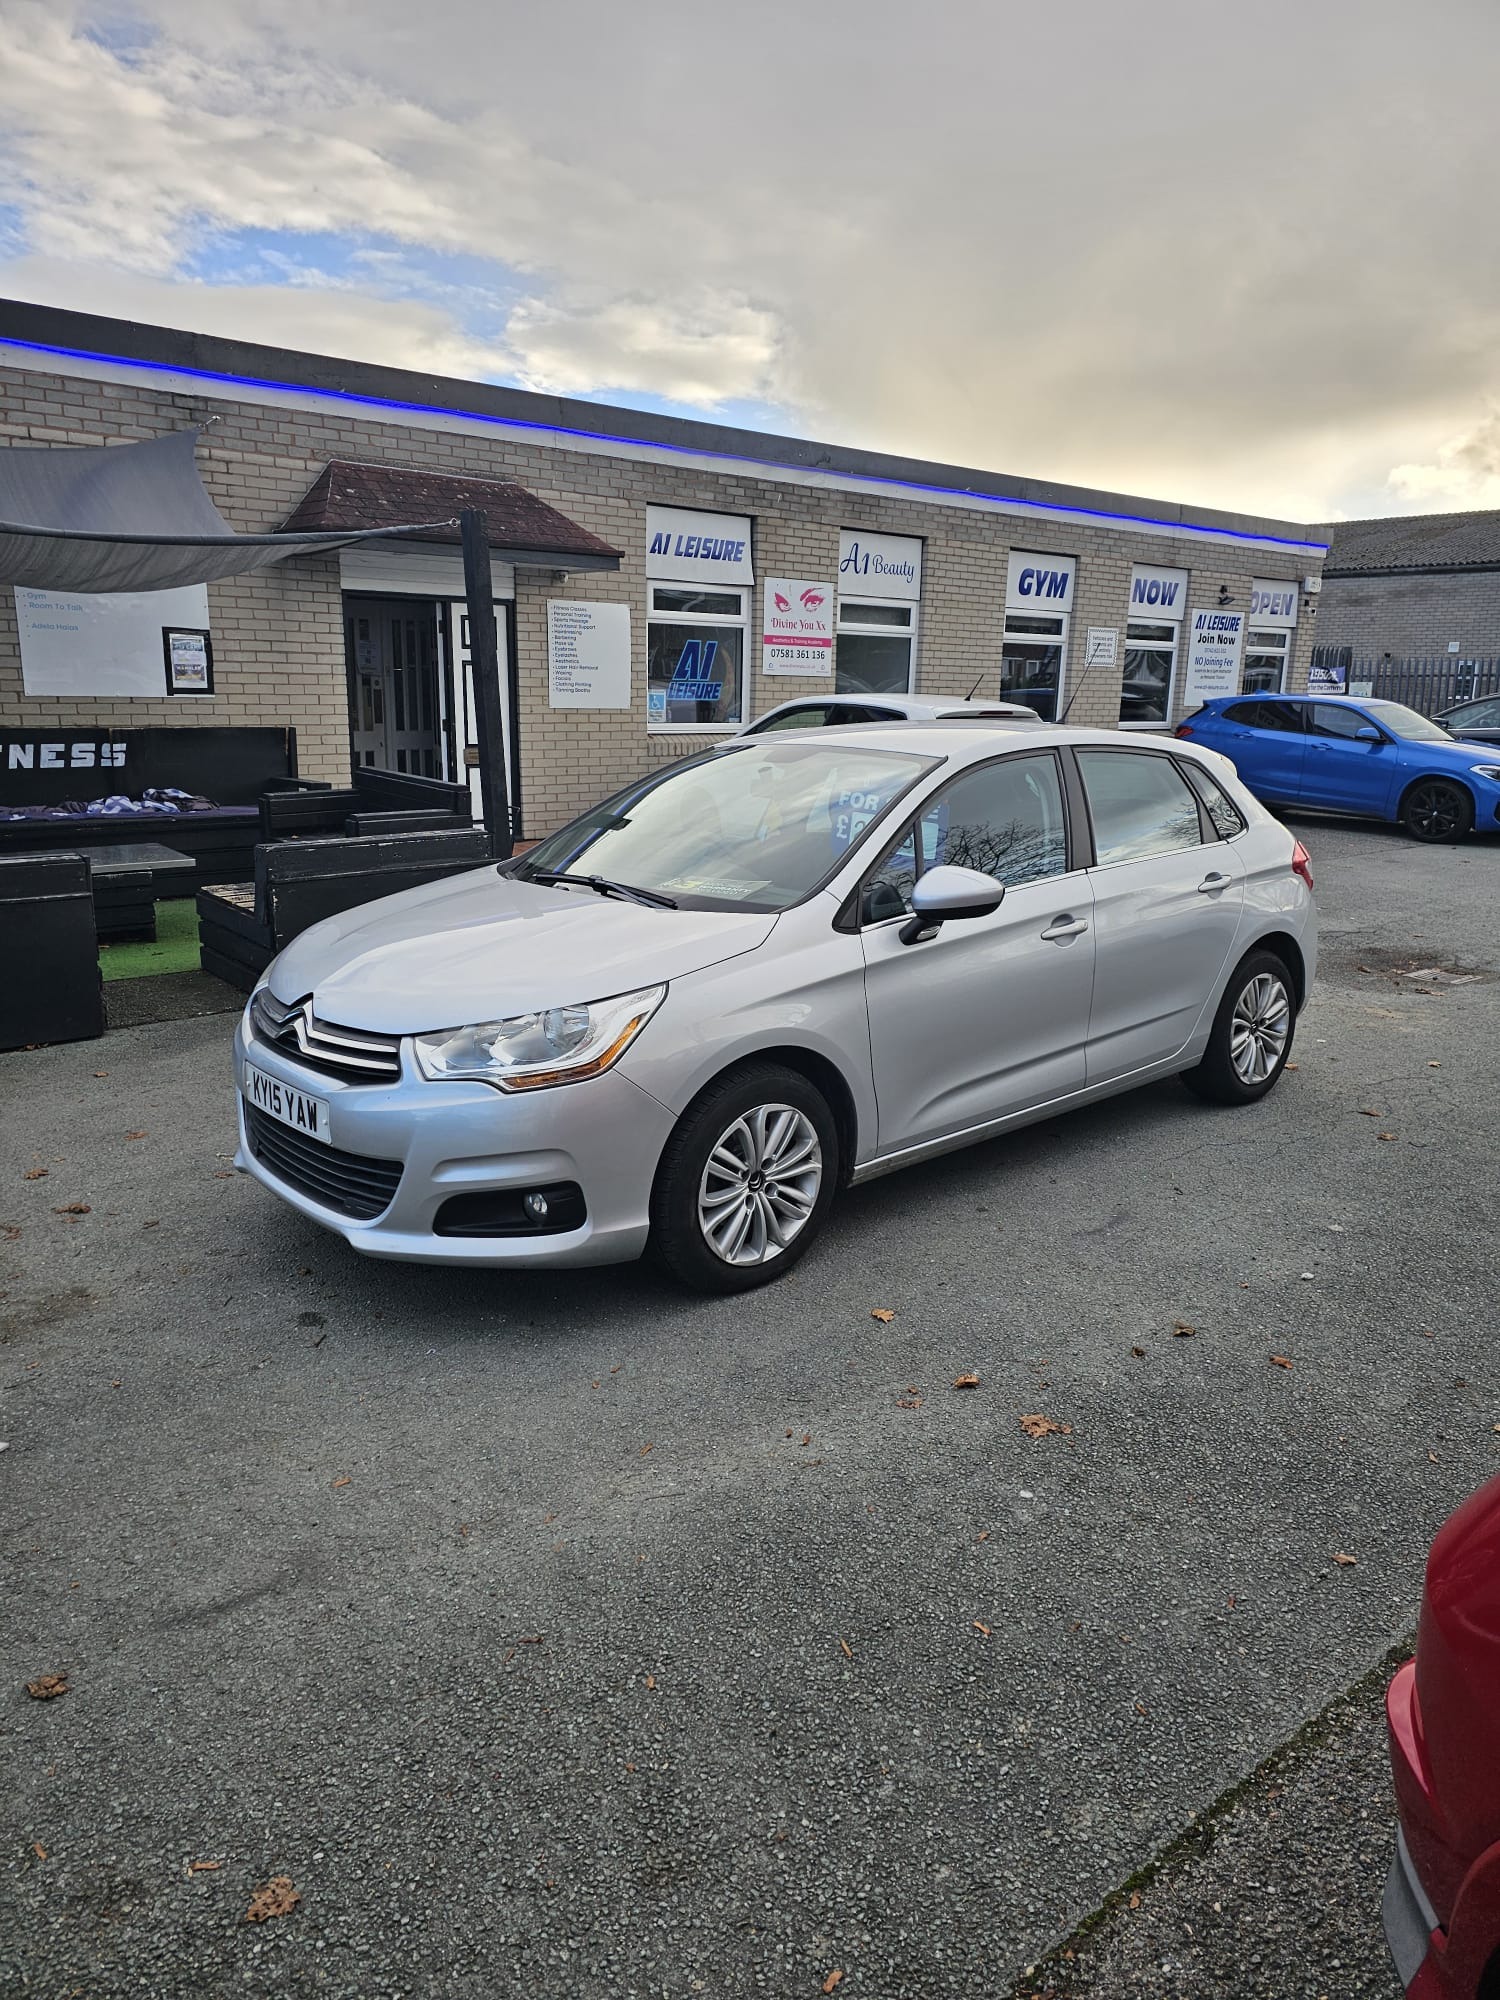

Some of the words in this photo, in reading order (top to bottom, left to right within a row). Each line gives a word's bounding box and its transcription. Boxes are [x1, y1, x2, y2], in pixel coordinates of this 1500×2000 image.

[674, 534, 746, 563] LEISURE
[840, 542, 870, 575] A1
[872, 554, 915, 584] Beauty
[1018, 567, 1069, 599] GYM
[1132, 578, 1179, 606] NOW
[27, 592, 47, 600] Gym
[1249, 591, 1294, 616] OPEN
[66, 603, 83, 611] Talk
[771, 617, 798, 630] Divine
[799, 619, 814, 632] You
[816, 620, 826, 631] Xx
[1207, 615, 1241, 632] LEISURE
[1197, 633, 1215, 644] Join
[1217, 634, 1236, 645] Now
[771, 649, 793, 659] 07581
[796, 649, 809, 659] 361
[812, 650, 825, 660] 136
[1195, 656, 1203, 665] NO
[1224, 658, 1234, 666] Fee
[667, 682, 723, 701] LEISURE
[0, 743, 127, 769] NESS
[839, 789, 880, 811] FOR
[253, 1071, 282, 1115] KY15
[285, 1089, 317, 1132] YAW
